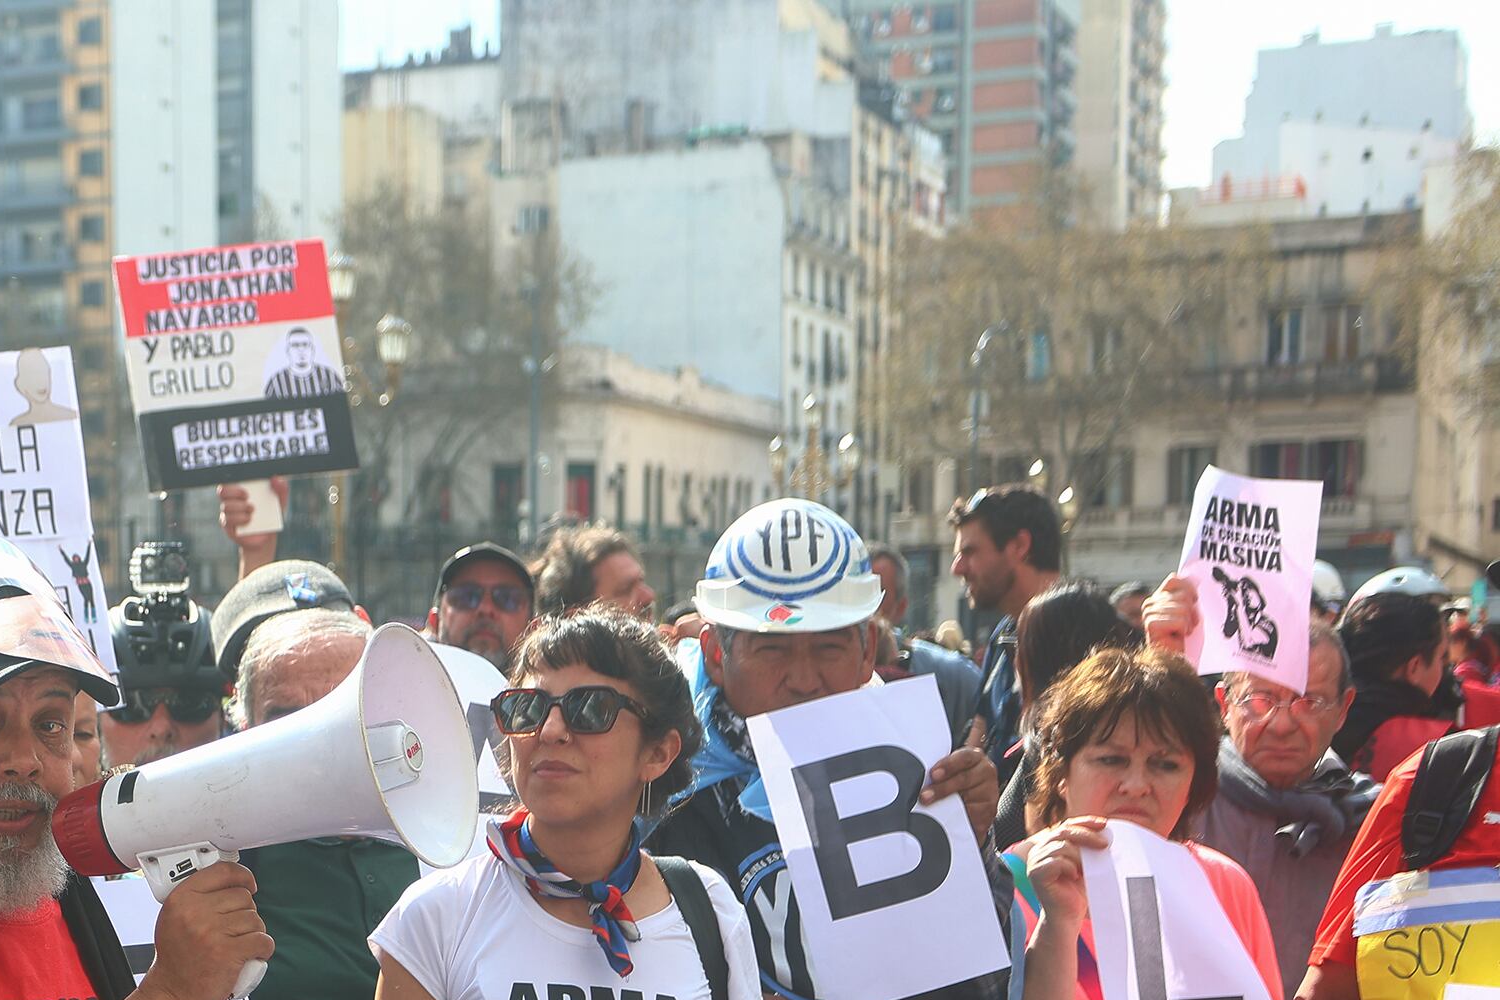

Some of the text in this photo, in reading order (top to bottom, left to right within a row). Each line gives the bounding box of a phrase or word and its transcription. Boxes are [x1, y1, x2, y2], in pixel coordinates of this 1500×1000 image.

[141, 245, 294, 281] JUSTICIA POR
[171, 270, 295, 305] JONATHAN
[146, 302, 257, 334] NAVARRO
[142, 330, 234, 364] Y PABLO
[149, 362, 234, 397] GRILLO
[186, 409, 320, 443] BULLRICH ES
[180, 433, 329, 467] RESPONSABLE
[1202, 524, 1214, 537] DE
[1204, 495, 1280, 533] ARMA
[757, 509, 825, 574] YPF
[1200, 540, 1282, 573] MASIVA
[791, 744, 952, 922] B
[1384, 923, 1472, 980] SOY
